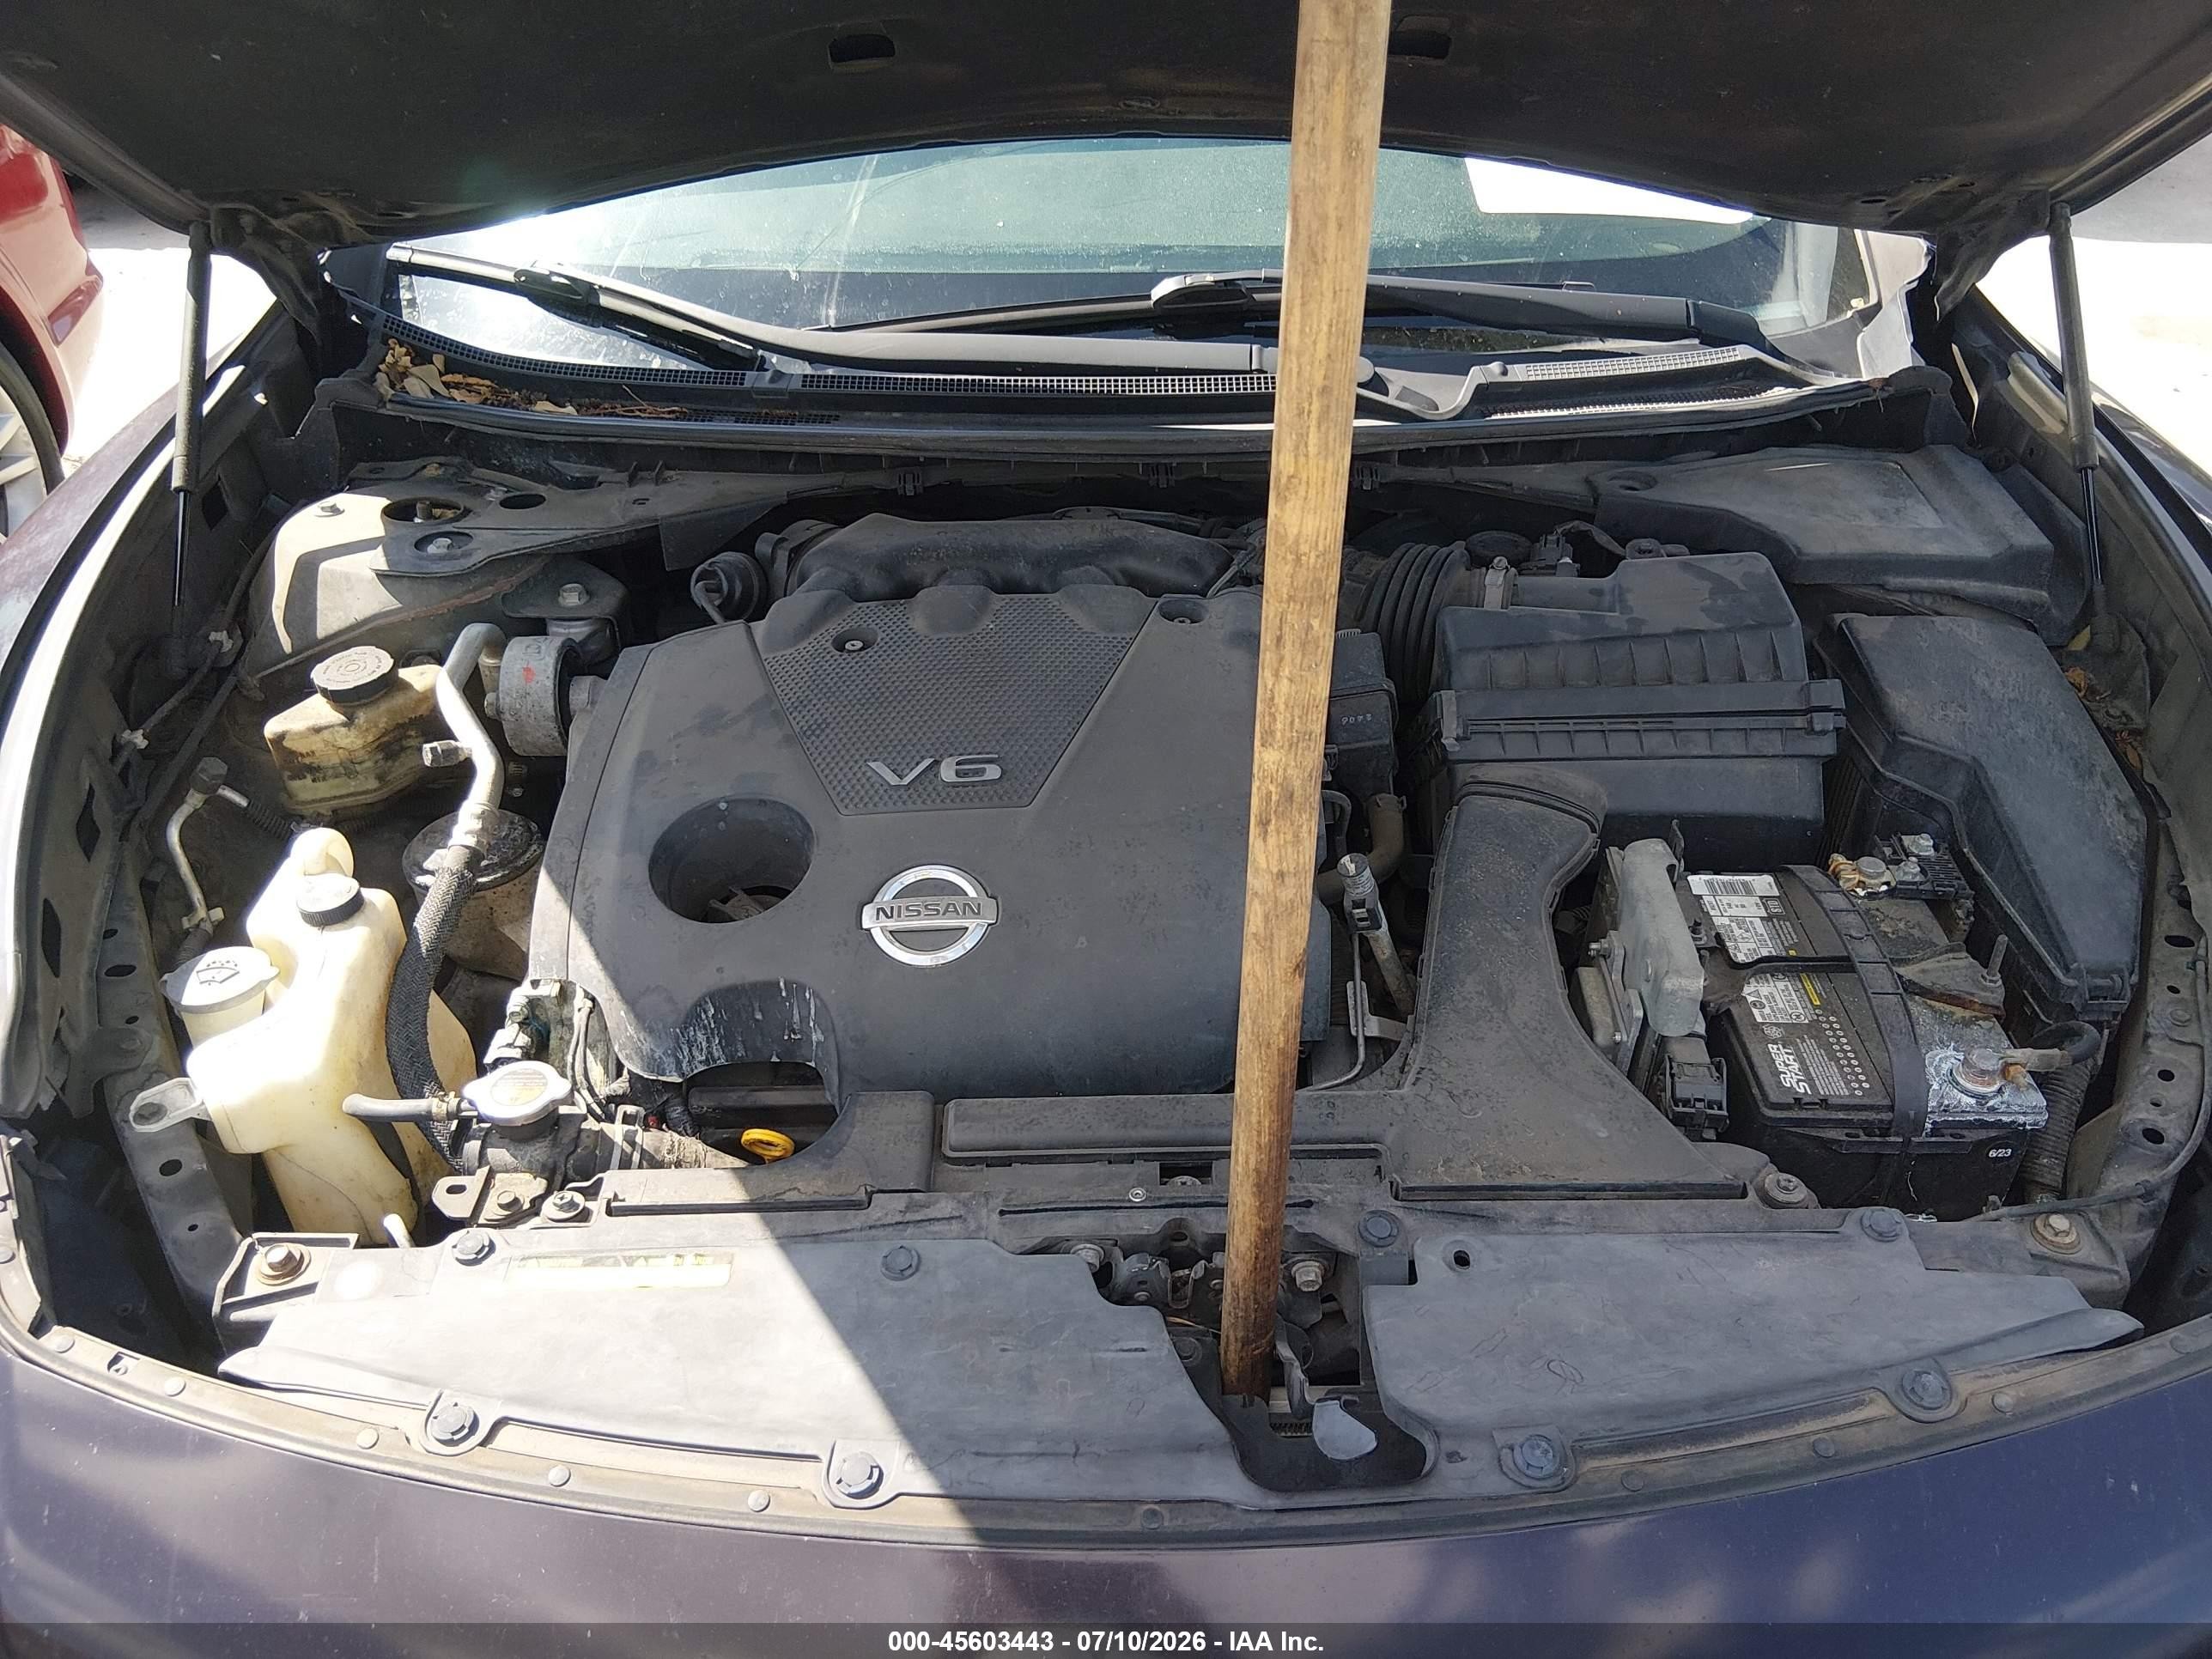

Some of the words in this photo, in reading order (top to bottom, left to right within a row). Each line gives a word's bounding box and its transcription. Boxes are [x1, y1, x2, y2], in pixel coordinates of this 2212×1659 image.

[866, 754, 1002, 786] V6
[876, 901, 982, 921] NISSAN
[1767, 1043, 1792, 1088] SUPER
[1778, 1043, 1812, 1095] START
[1988, 1148, 2013, 1158] 6/23
